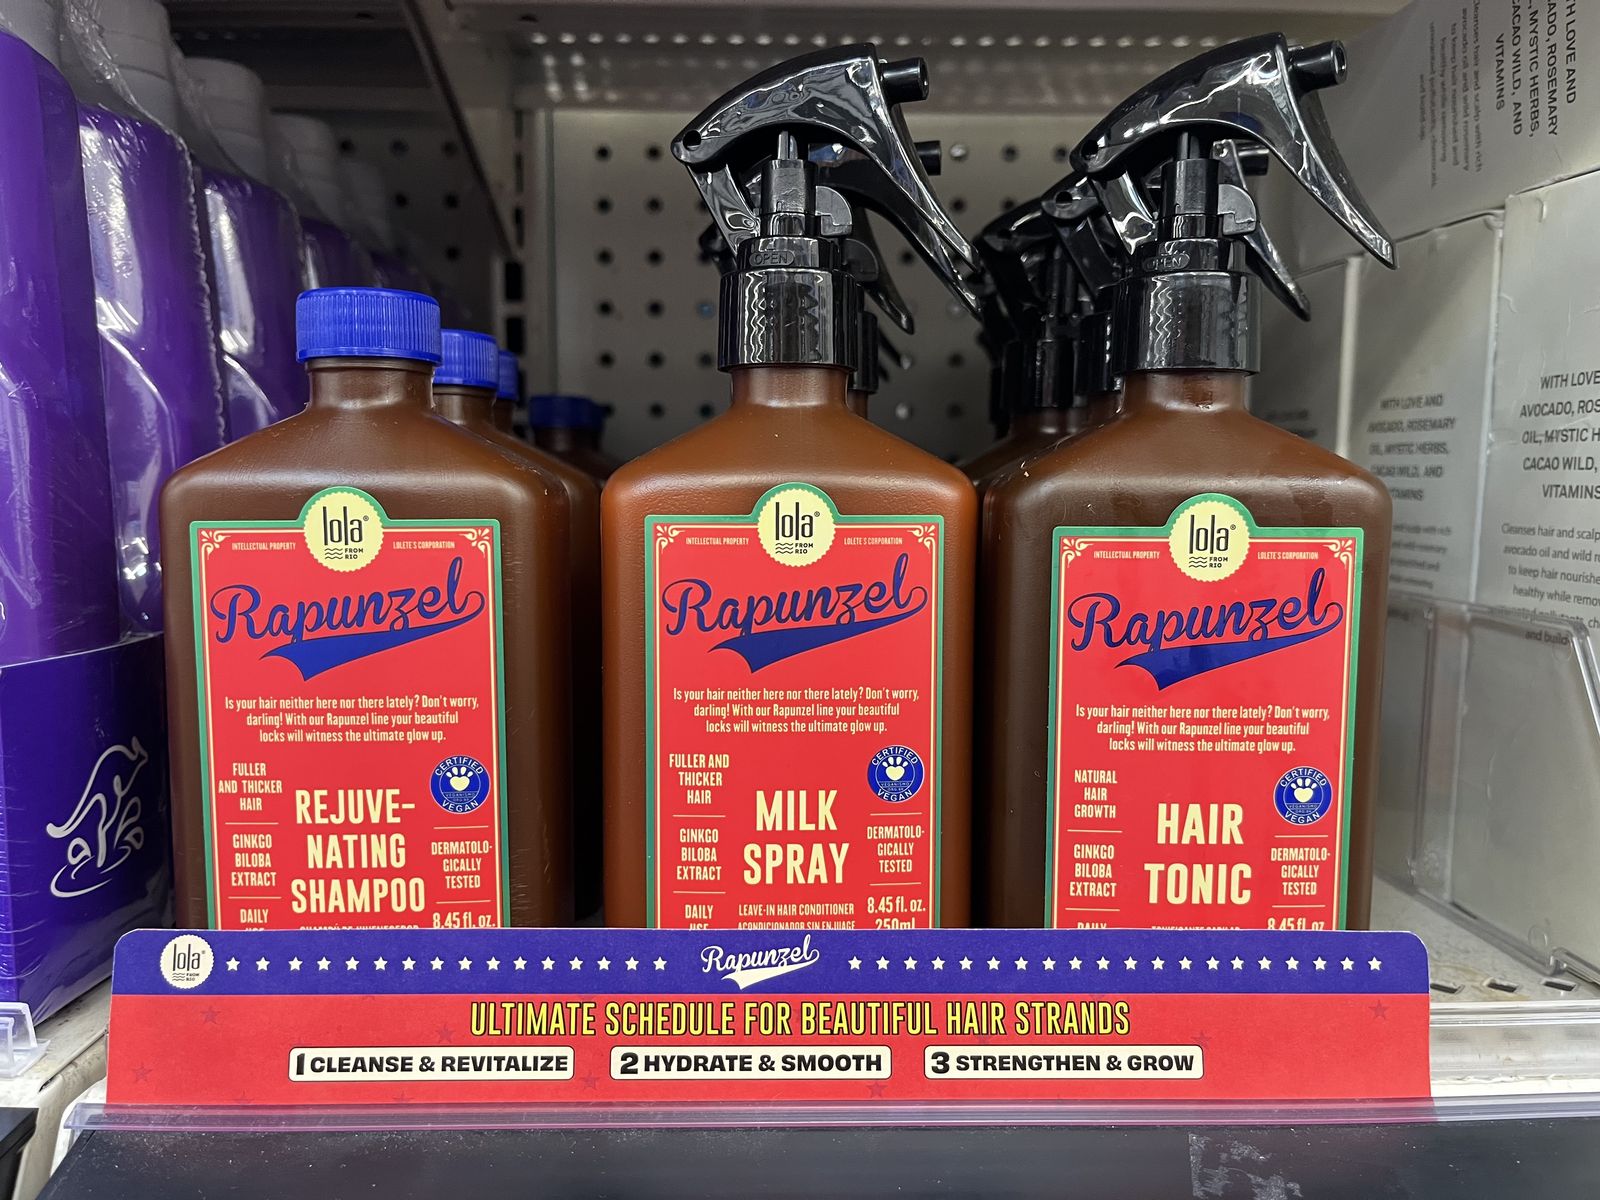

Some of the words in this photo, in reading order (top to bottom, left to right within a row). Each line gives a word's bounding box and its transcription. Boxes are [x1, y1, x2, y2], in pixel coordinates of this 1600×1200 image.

[1529, 10, 1538, 70] MYSTIC
[1566, 18, 1576, 65] LOVE
[1495, 33, 1504, 110] VITAMINS
[1511, 50, 1521, 95] WILD,
[1547, 44, 1557, 136] ROSEMARY
[1566, 69, 1577, 103] AND
[1529, 75, 1539, 137] HERBS,
[1513, 102, 1522, 135] AND
[754, 253, 787, 264] OPEN
[1541, 374, 1568, 389] WITH
[1571, 371, 1600, 386] LOVE
[1520, 402, 1574, 417] AVOCADO,
[1578, 400, 1600, 413] ROS
[1522, 431, 1542, 446] OIL,
[1545, 428, 1587, 443] MYSTIC
[1523, 457, 1559, 470] CACAO
[1562, 457, 1597, 472] WILD,
[1543, 484, 1600, 499] VITAMINS
[232, 542, 268, 550] INTELLECTUAL
[269, 542, 296, 550] PROPERTY
[418, 541, 455, 549] CORPORATION
[686, 537, 722, 545] INTELLECTUAL
[723, 537, 749, 545] PROPERTY
[867, 537, 903, 545] CORPORATION
[1094, 551, 1132, 559] INTELLECTUAL
[1132, 551, 1160, 559] PROPERTY
[1282, 552, 1319, 560] CORPORATION
[211, 556, 485, 643] Rapunzel
[662, 553, 928, 636] Rapunzel
[1068, 568, 1342, 651] Rapunzel
[674, 688, 682, 700] Is
[684, 691, 704, 703] your
[707, 688, 725, 700] hair
[727, 688, 761, 700] neither
[763, 688, 784, 700] here
[786, 690, 802, 700] nor
[804, 688, 829, 700] there
[832, 686, 864, 702] lately?
[866, 687, 889, 699] Don't
[892, 690, 919, 702] worry,
[225, 697, 234, 709] Is
[236, 700, 257, 712] your
[259, 697, 277, 709] hair
[280, 697, 314, 709] neither
[316, 696, 337, 709] here
[340, 699, 355, 709] nor
[358, 696, 384, 708] there
[386, 694, 420, 711] lately?
[422, 695, 447, 708] Don't
[449, 697, 479, 709] worry,
[694, 703, 730, 719] darling!
[732, 704, 753, 716] With
[756, 707, 771, 716] our
[773, 704, 814, 719] Rapunzel
[817, 704, 834, 716] line
[836, 706, 856, 719] your
[858, 703, 899, 716] beautiful
[706, 720, 731, 732] locks
[733, 720, 749, 732] will
[751, 720, 788, 732] witness
[791, 720, 806, 732] the
[808, 720, 848, 732] ultimate
[850, 720, 871, 735] glow
[874, 722, 887, 734] up.
[669, 753, 706, 768] FULLER
[708, 754, 729, 768] AND
[871, 746, 918, 767] CERTIFIED
[233, 763, 266, 776] FULLER
[434, 756, 483, 776] CERTIFIED
[678, 771, 722, 786] THICKER
[1074, 770, 1117, 784] NATURAL
[1279, 768, 1328, 787] CERTIFIED
[218, 780, 238, 793] AND
[242, 780, 282, 793] THICKER
[1084, 787, 1107, 801] HAIR
[687, 790, 711, 804] HAIR
[877, 789, 913, 802] VEGAN
[240, 797, 262, 811] HAIR
[295, 789, 415, 824] REJUVE-
[442, 800, 479, 813] VEGAN
[756, 790, 837, 831] MILK
[1074, 804, 1116, 818] GROWTH
[1157, 803, 1244, 844] HAIR
[1284, 811, 1320, 824] VEGAN
[680, 828, 718, 843] GINKGO
[867, 825, 924, 839] DERMATOLO-
[233, 834, 272, 849] GINKGO
[431, 840, 492, 855] DERMATOLO-
[878, 842, 914, 856] GICALLY
[307, 833, 406, 869] NATING
[681, 847, 717, 862] BILOBA
[1074, 844, 1114, 859] GINKGO
[1271, 847, 1330, 861] DERMATOLO-
[235, 853, 271, 867] BILOBA
[443, 858, 481, 872] GICALLY
[744, 843, 849, 885] SPRAY
[879, 859, 912, 873] TESTED
[677, 866, 722, 880] EXTRACT
[1075, 863, 1112, 878] BILOBA
[1281, 865, 1319, 878] GICALLY
[231, 872, 276, 886] EXTRACT
[445, 875, 480, 889] TESTED
[1144, 863, 1252, 905] TONIC
[291, 877, 425, 913] SHAMPOO
[1070, 881, 1117, 897] EXTRACT
[1282, 882, 1317, 895] TESTED
[685, 904, 713, 919] DAILY
[739, 904, 775, 916] LEAVE-IN
[777, 904, 797, 916] HAIR
[799, 903, 854, 916] CONDITIONER
[867, 896, 893, 914] 8.45
[895, 896, 907, 912] fl.
[910, 899, 926, 912] oz.
[240, 909, 268, 923] DAILY
[433, 912, 459, 928] 8.45
[462, 912, 476, 928] fl.
[478, 915, 495, 928] oz.
[701, 934, 819, 974] Rapunzel
[471, 1002, 596, 1036] ULTIMATE
[606, 1002, 735, 1036] SCHEDULE
[744, 1002, 791, 1036] FOR
[801, 1001, 937, 1035] BEAUTIFUL
[947, 1001, 1005, 1035] HAIR
[1015, 1001, 1130, 1035] STRANDS
[296, 1053, 305, 1075] 1
[311, 1057, 413, 1073] CLEANSE
[419, 1056, 435, 1072] &
[441, 1056, 568, 1072] REVITALIZE
[620, 1052, 638, 1074] 2
[644, 1055, 752, 1072] HYDRATE
[758, 1055, 775, 1071] &
[782, 1055, 881, 1071] SMOOTH
[931, 1052, 950, 1074] 3
[956, 1055, 1100, 1071] STRENGTHEN
[1106, 1055, 1122, 1071] &
[1127, 1055, 1194, 1071] GROW
